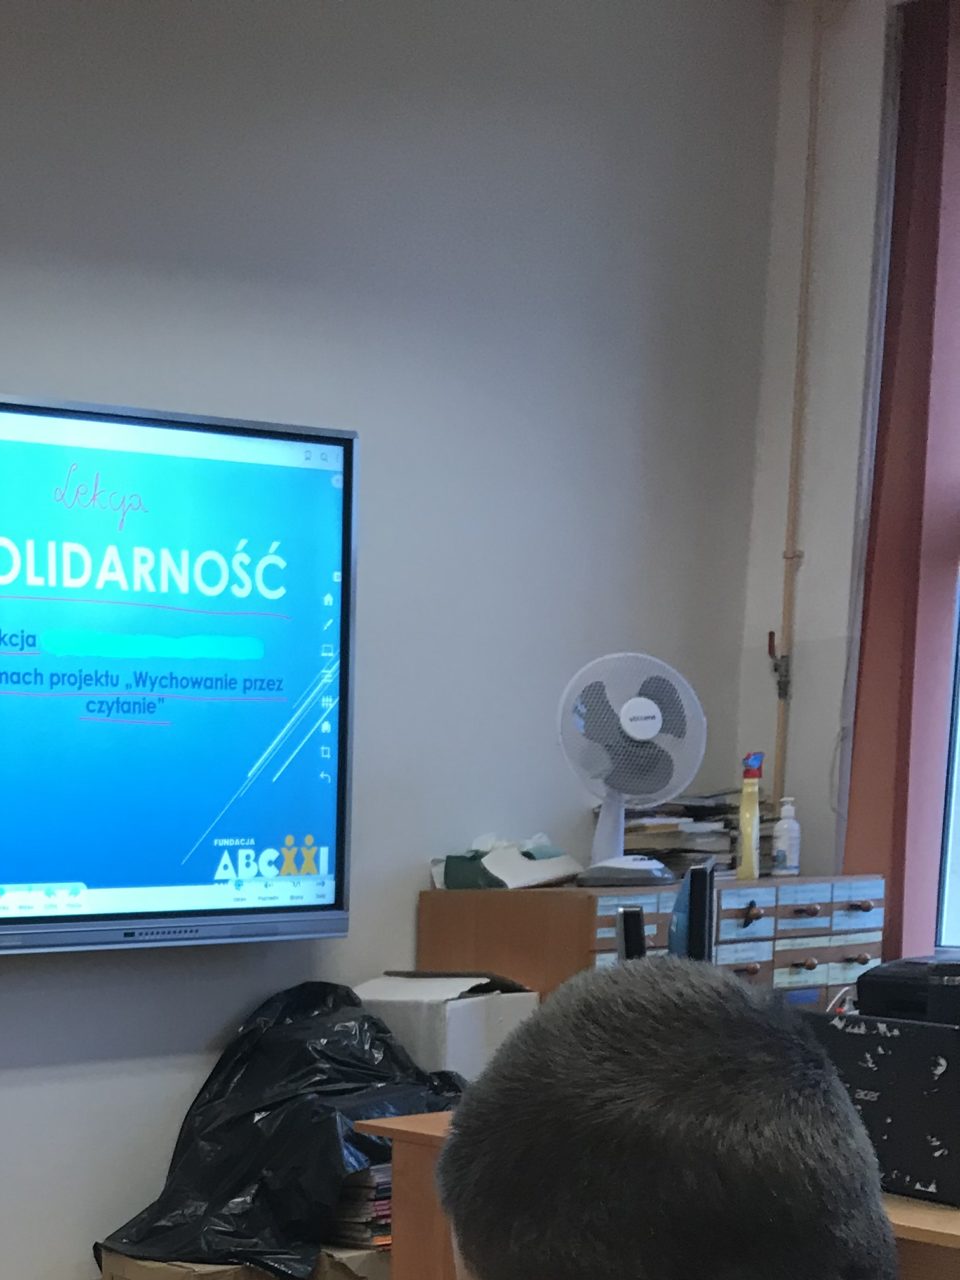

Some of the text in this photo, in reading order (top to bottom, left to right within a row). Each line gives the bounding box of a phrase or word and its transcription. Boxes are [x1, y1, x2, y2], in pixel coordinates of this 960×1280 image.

[54, 463, 149, 531] Lekcja
[49, 669, 120, 690] projektu
[125, 670, 238, 692] „Wychowanie
[243, 677, 284, 694] przez
[213, 838, 255, 846] FUNDACJA
[855, 1089, 880, 1101] acer
